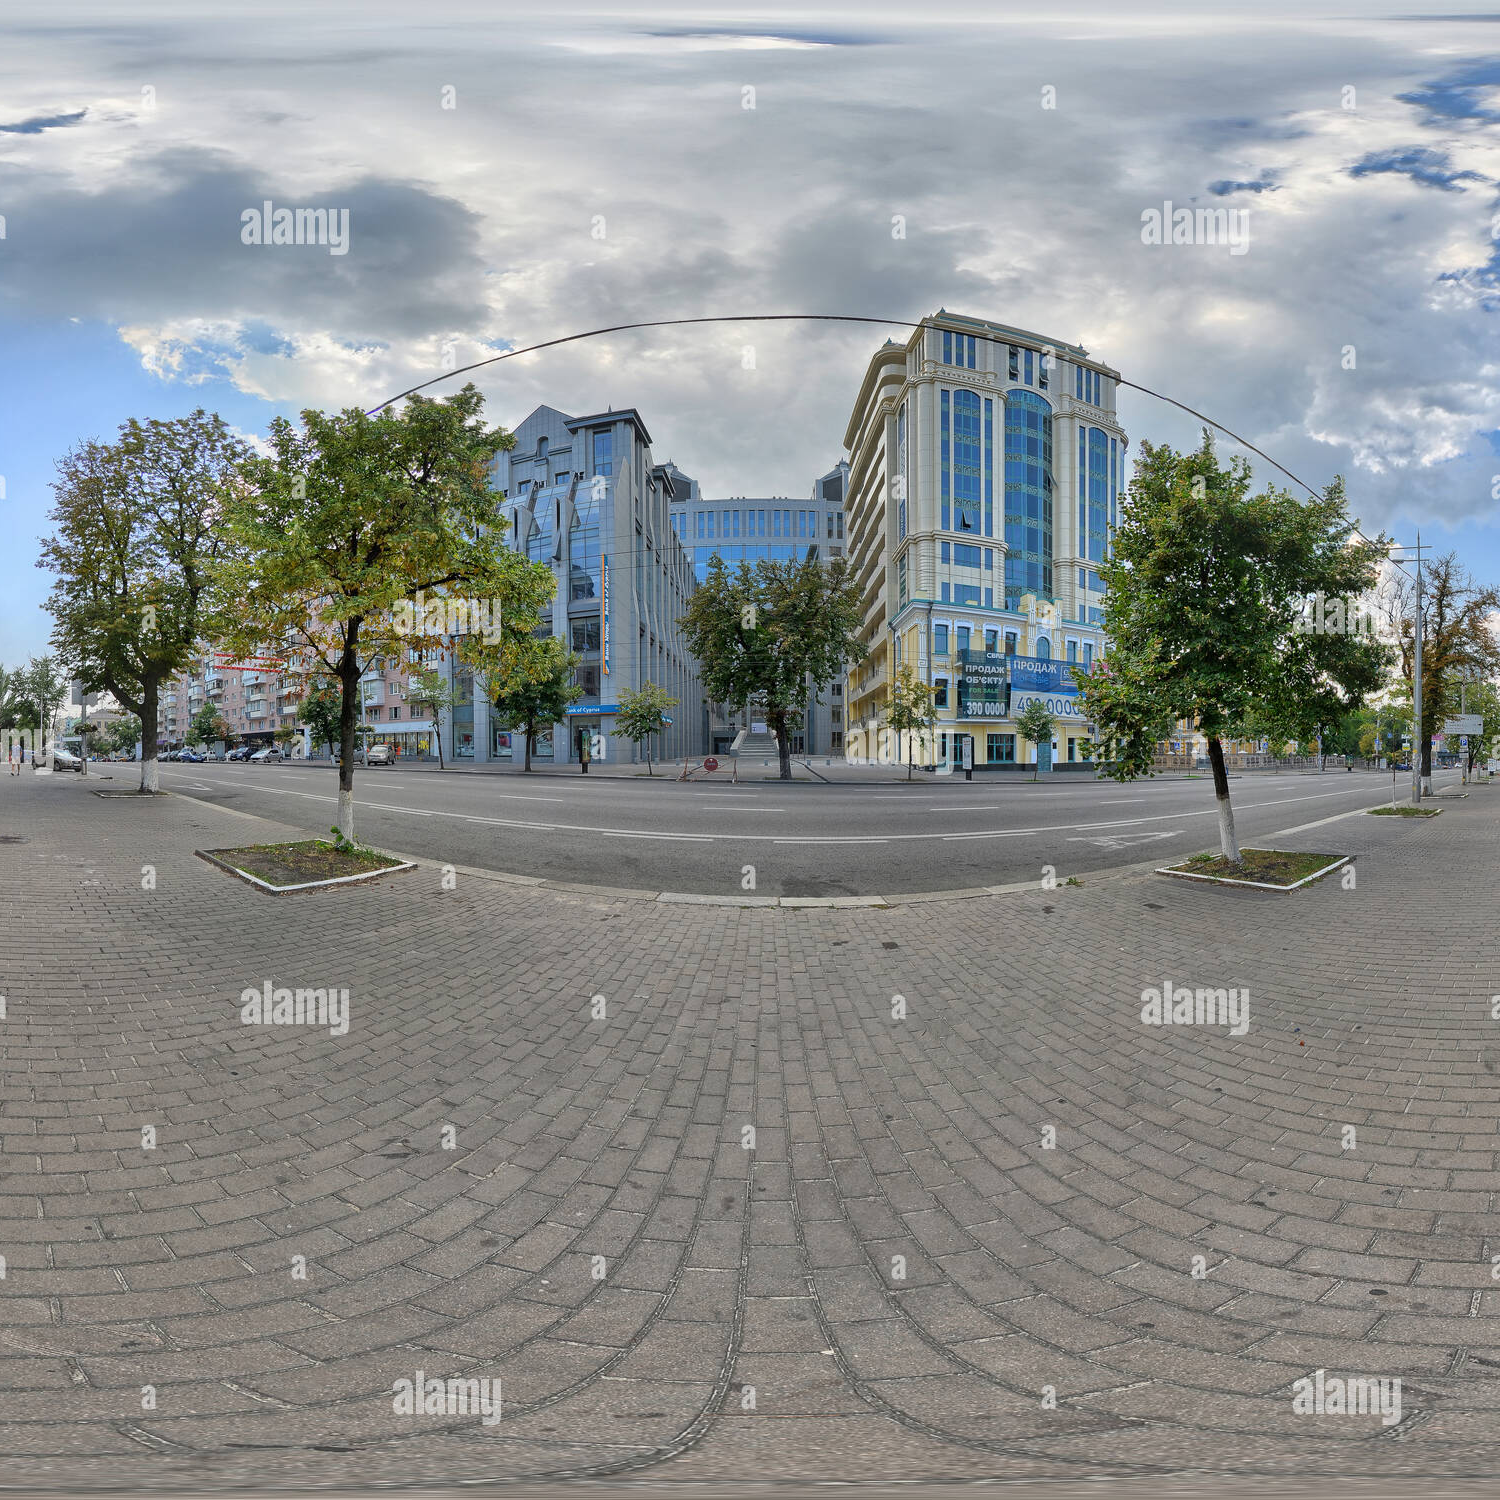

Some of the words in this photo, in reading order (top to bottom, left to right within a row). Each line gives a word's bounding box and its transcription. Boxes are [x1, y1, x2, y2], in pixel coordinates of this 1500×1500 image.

[965, 665, 1005, 674] ПРОДАЖ
[1014, 660, 1057, 674] ПРОДАЖ
[966, 702, 983, 715] 390
[985, 702, 1005, 716] 0000
